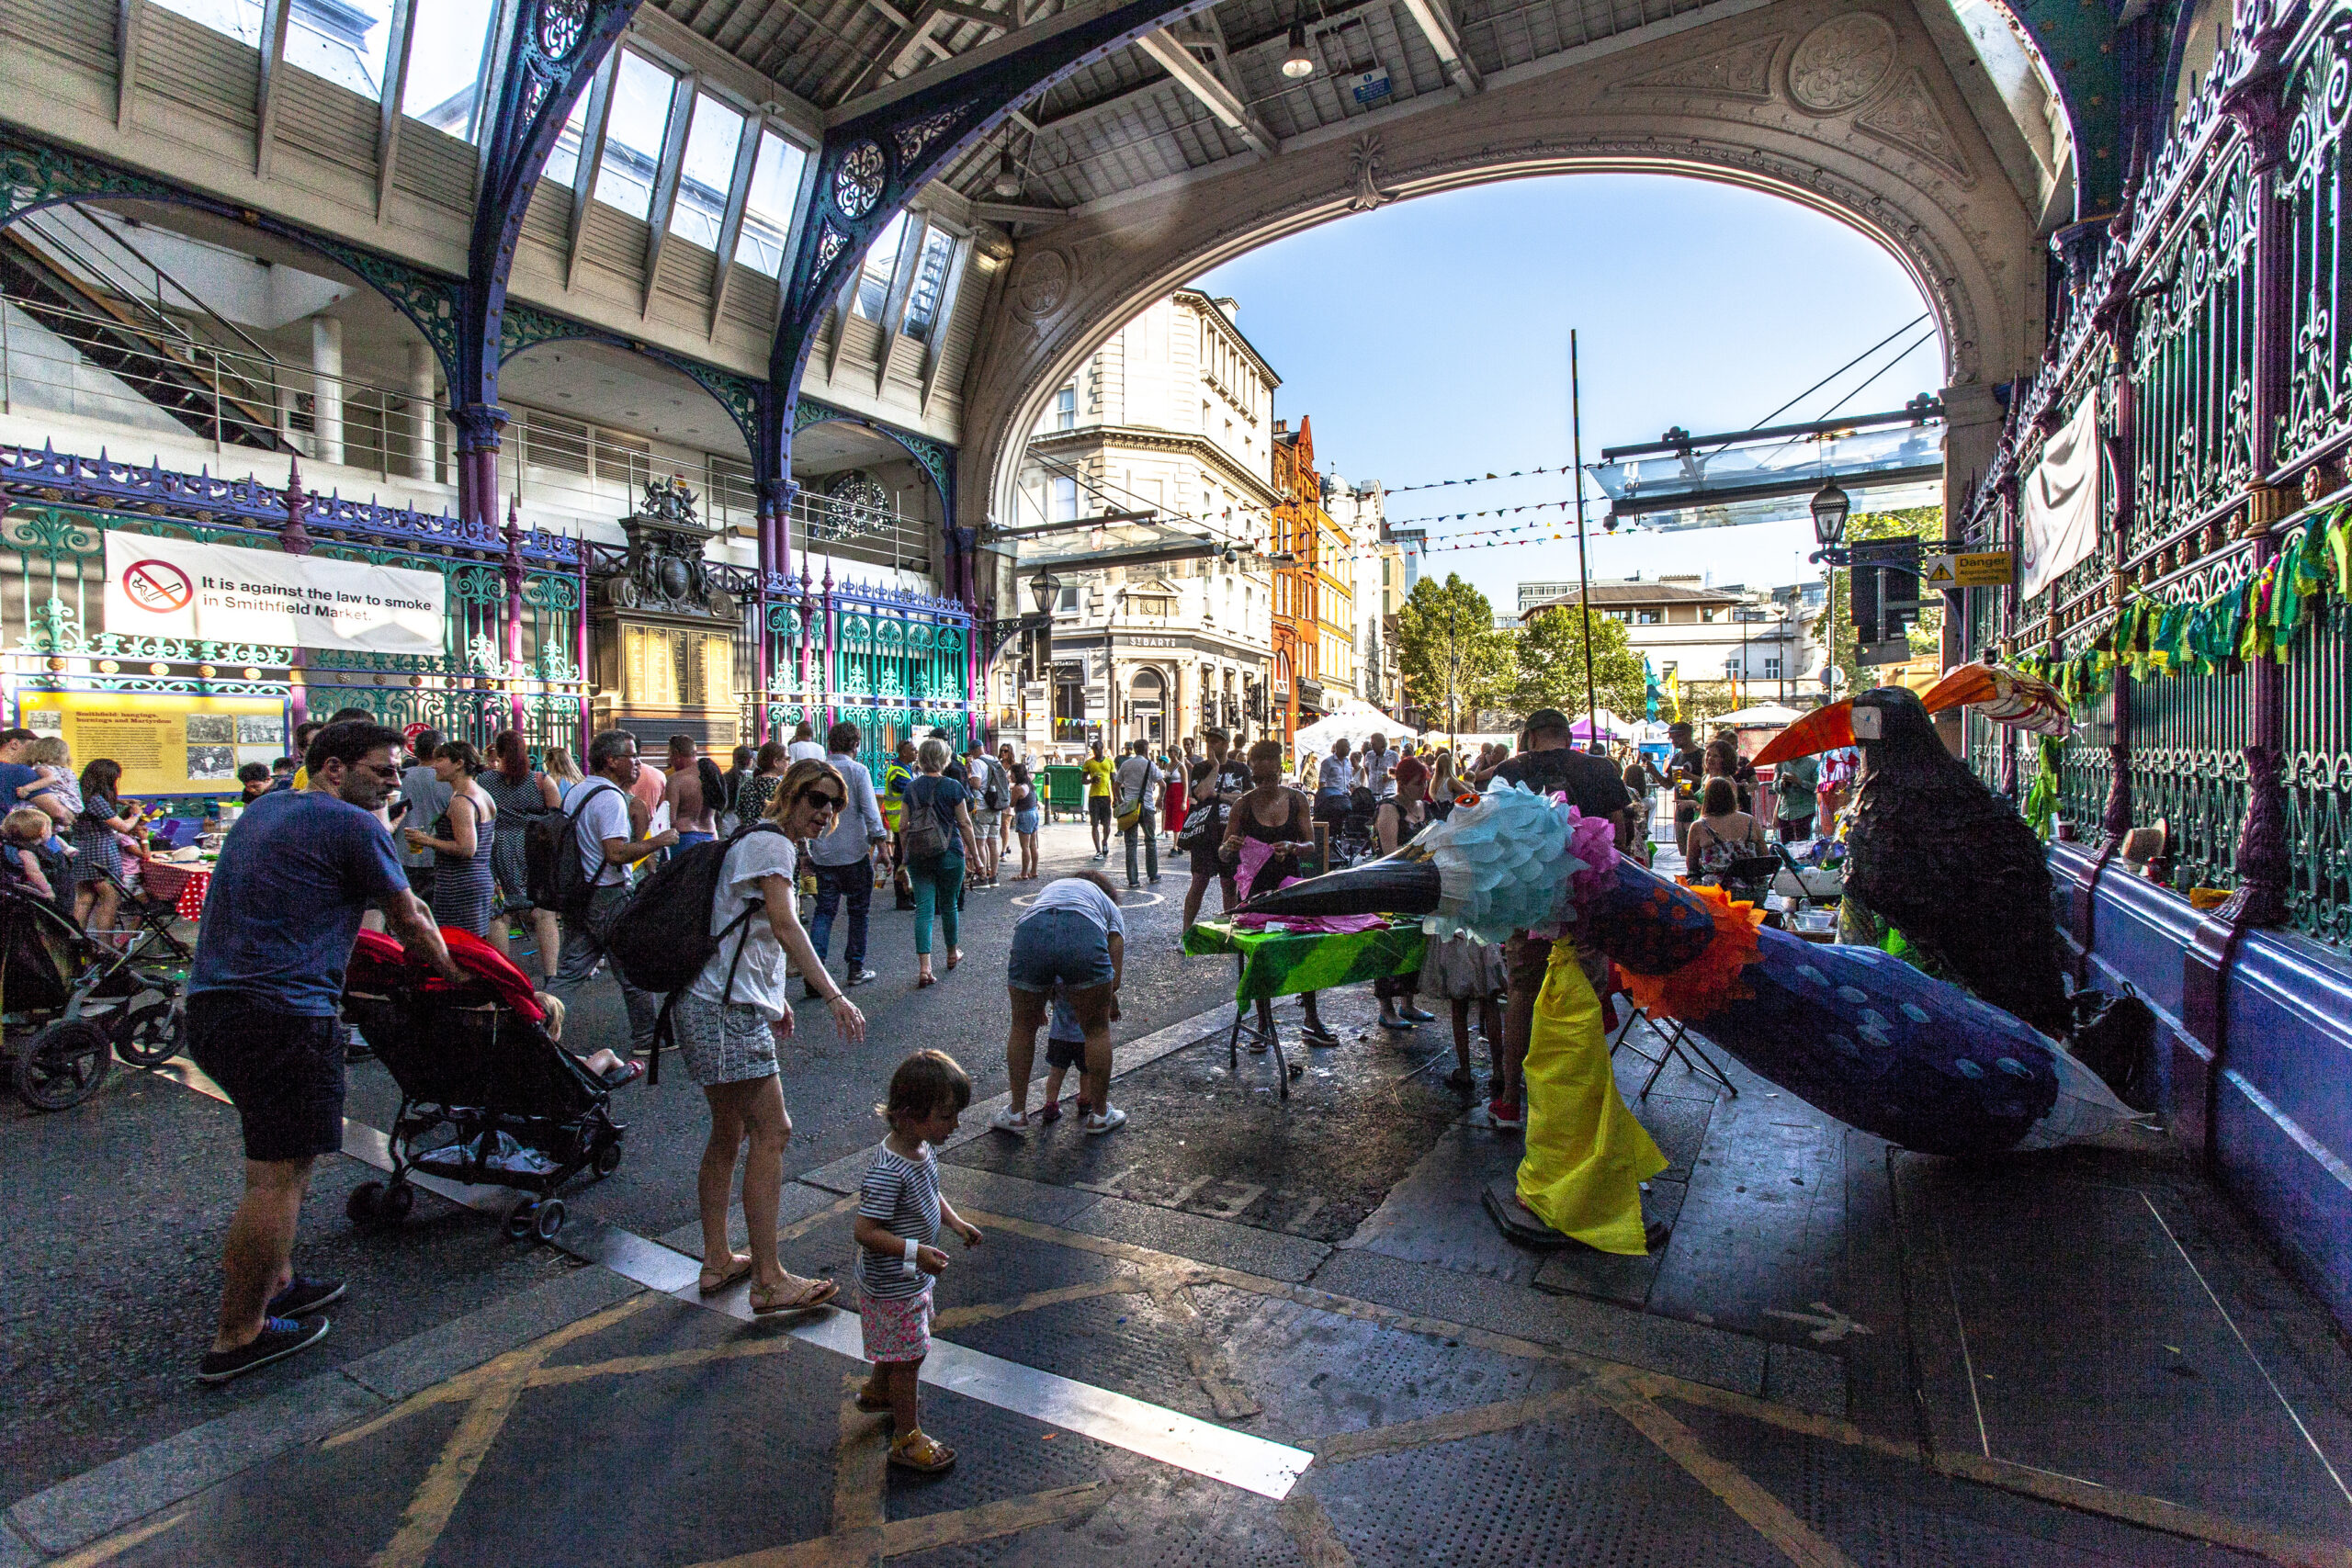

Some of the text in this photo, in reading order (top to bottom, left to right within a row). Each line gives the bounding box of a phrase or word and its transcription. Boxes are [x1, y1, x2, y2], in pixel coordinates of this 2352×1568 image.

[1960, 558, 2007, 568] Danger
[202, 576, 432, 611] It is against the law to smoke
[203, 593, 372, 622] in Smithfield Market.
